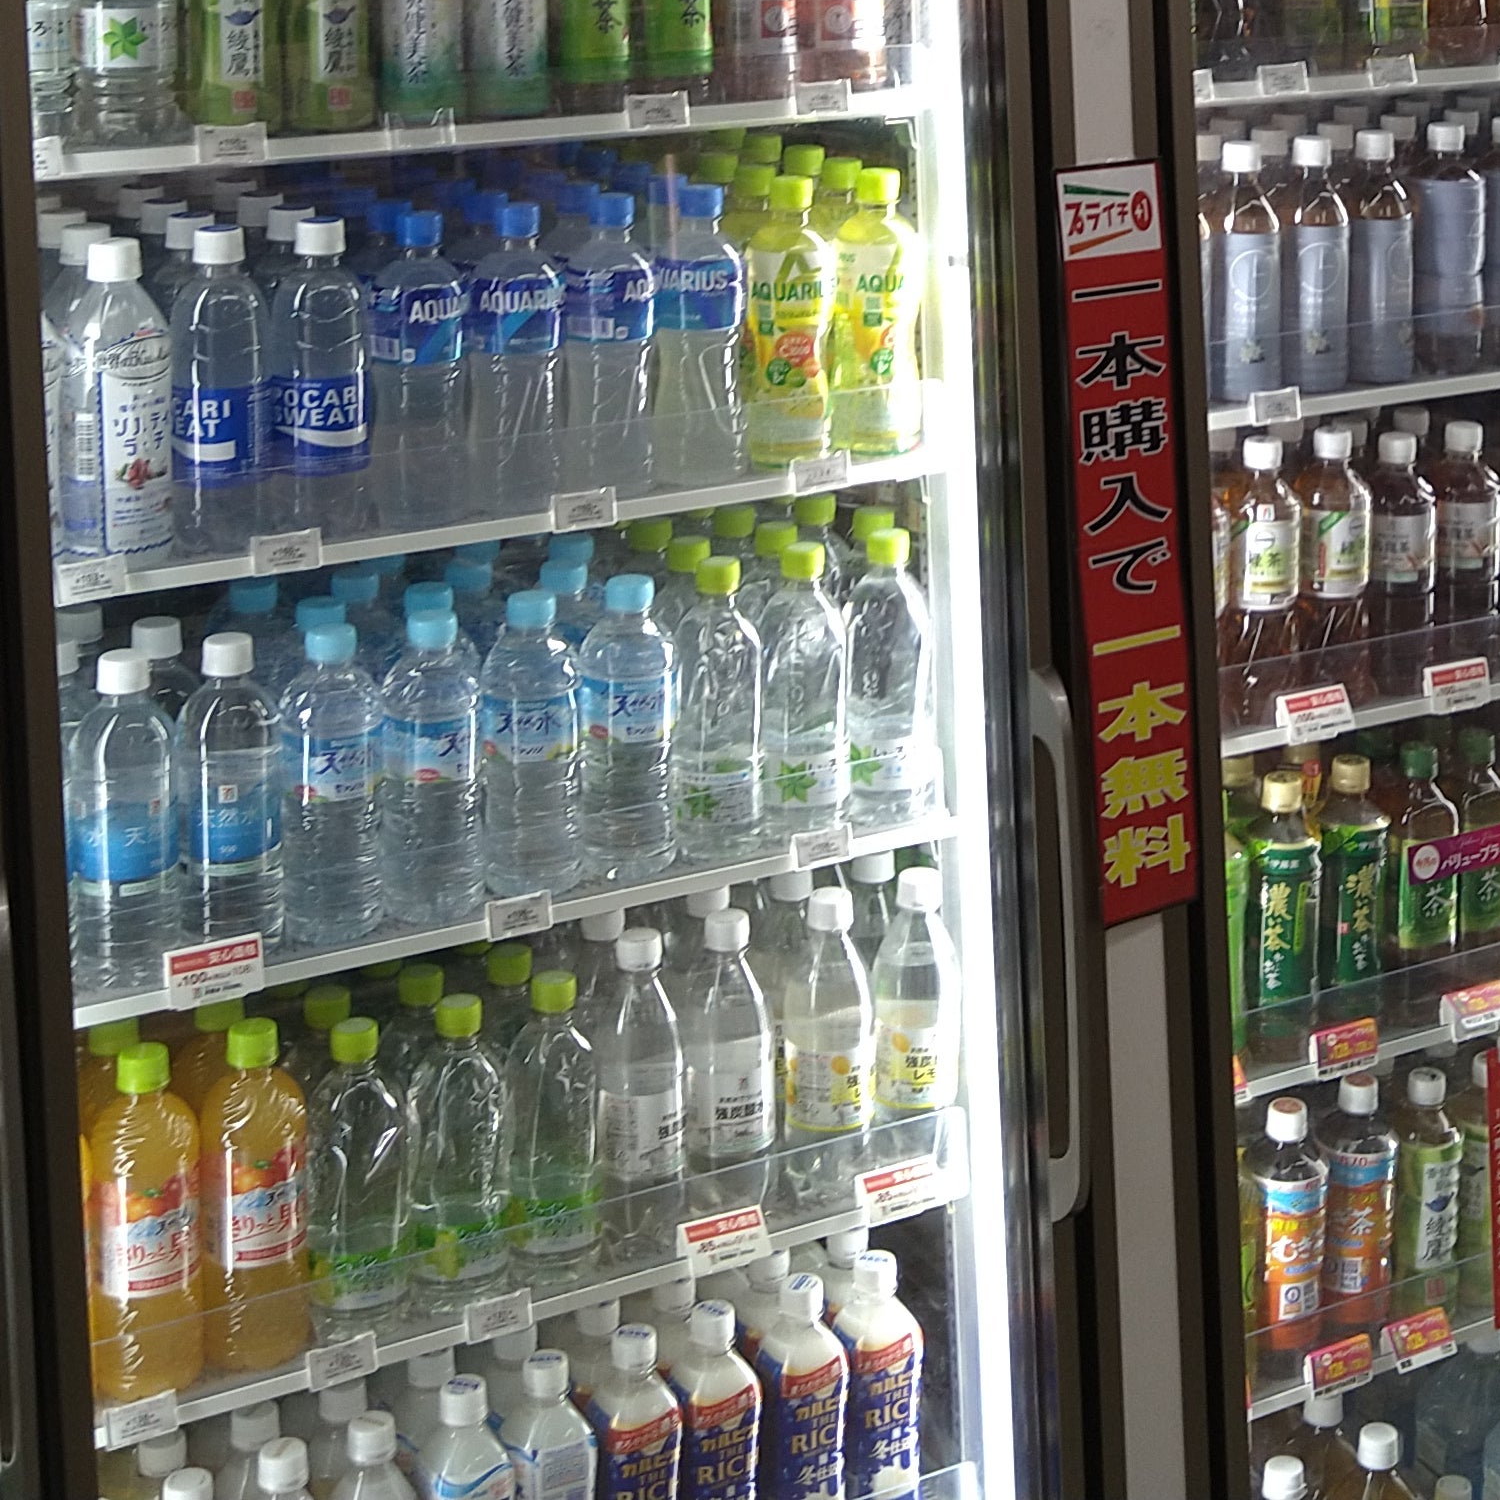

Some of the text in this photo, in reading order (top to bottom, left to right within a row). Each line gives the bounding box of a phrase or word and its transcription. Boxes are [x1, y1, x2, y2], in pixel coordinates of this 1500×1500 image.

[273, 385, 358, 410] POCAR
[1071, 278, 1191, 888] 一本購入で一本無料
